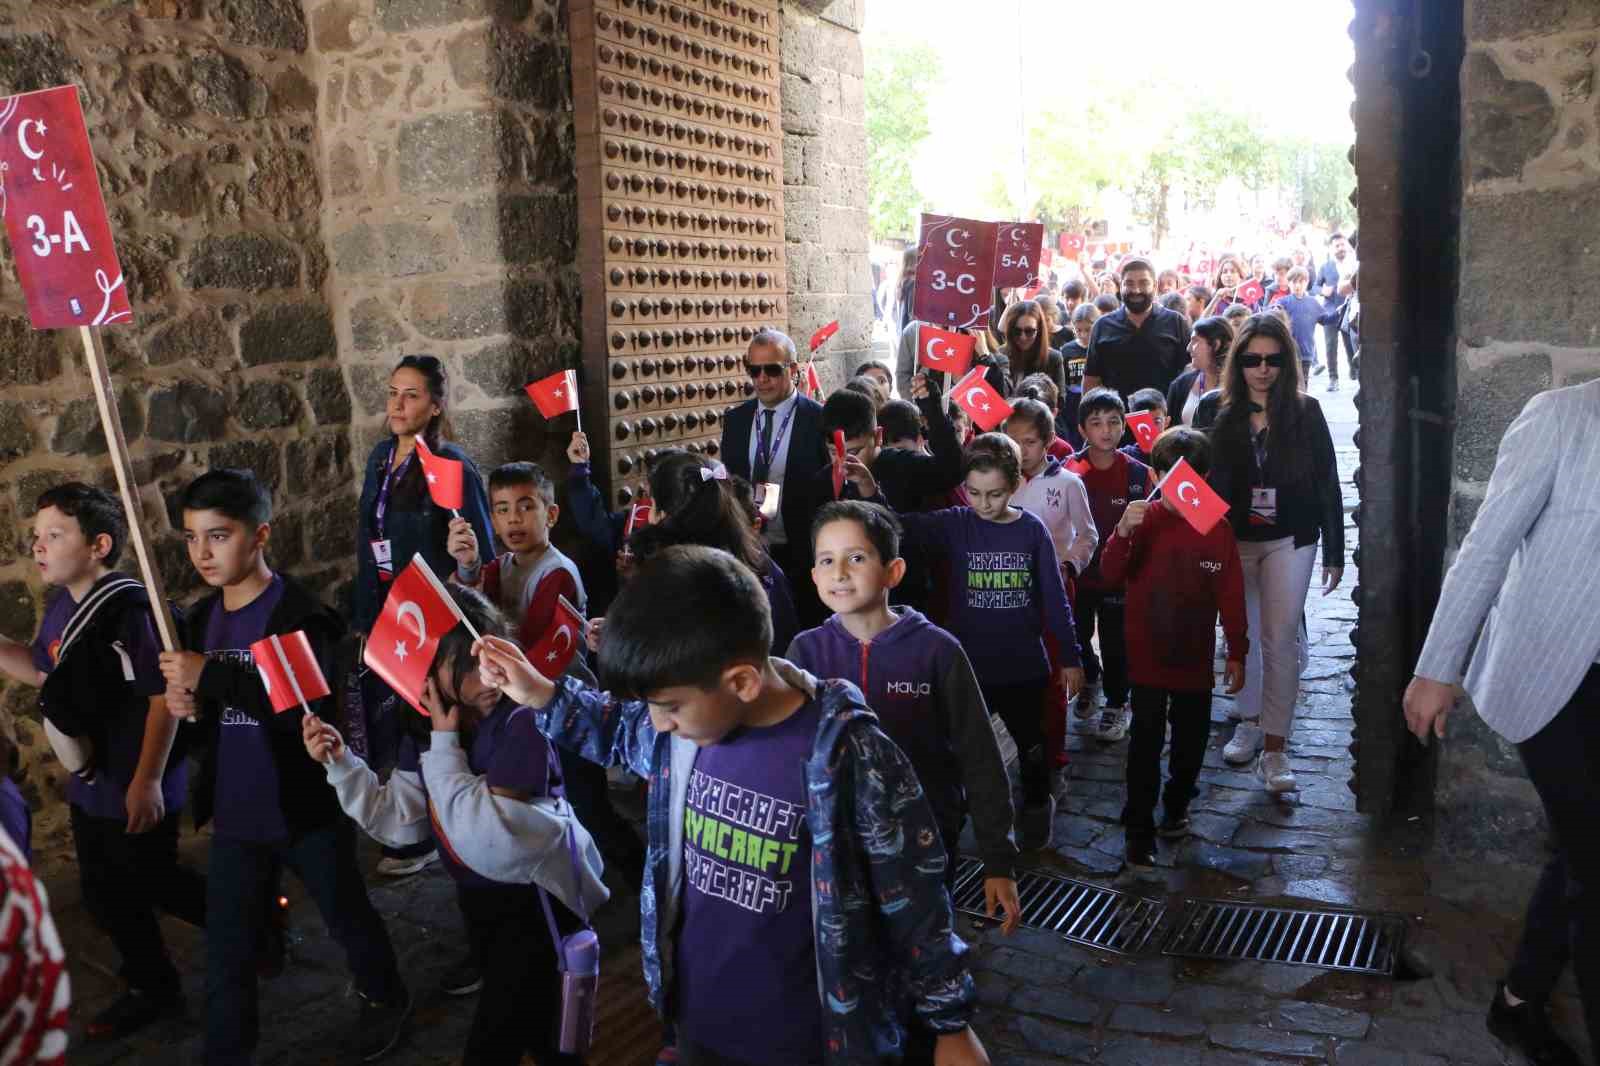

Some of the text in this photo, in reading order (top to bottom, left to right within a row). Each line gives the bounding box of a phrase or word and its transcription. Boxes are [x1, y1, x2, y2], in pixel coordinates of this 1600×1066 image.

[26, 210, 91, 257] 3-A
[1001, 254, 1030, 269] 5-A
[931, 269, 976, 295] 3-C
